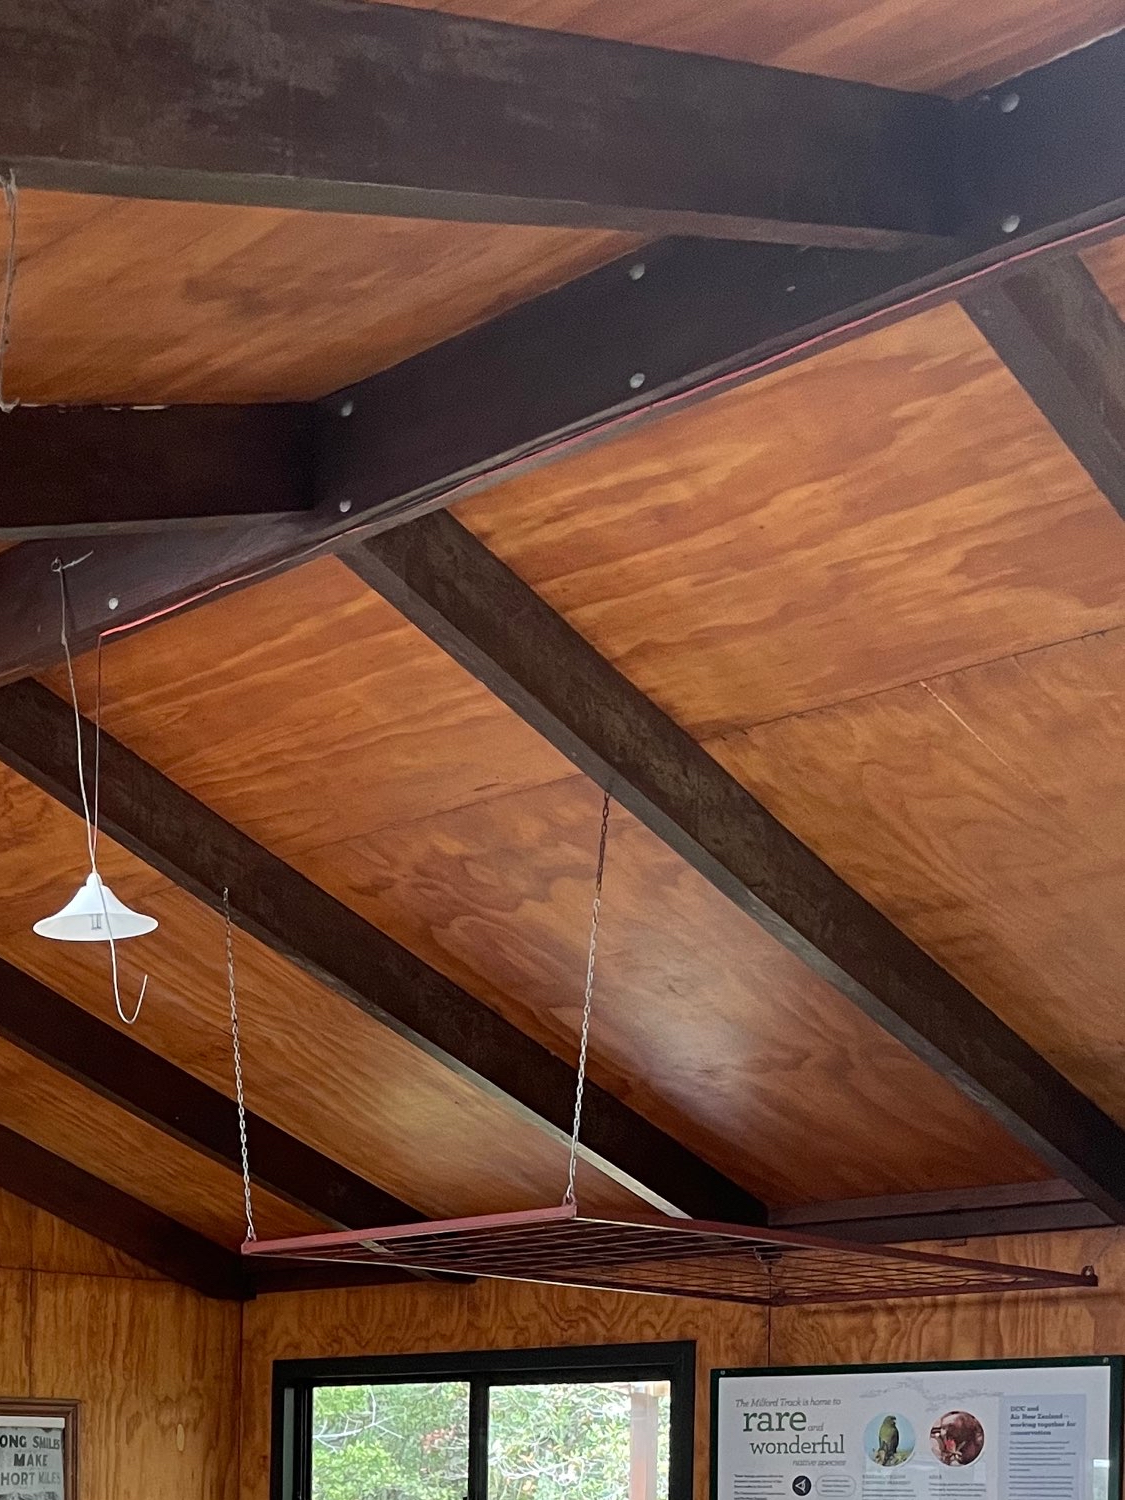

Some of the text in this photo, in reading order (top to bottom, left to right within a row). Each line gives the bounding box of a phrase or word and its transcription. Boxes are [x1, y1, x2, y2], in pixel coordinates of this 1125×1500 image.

[736, 1399, 749, 1407] The
[751, 1398, 778, 1407] Milford
[780, 1398, 800, 1406] Track
[810, 1397, 831, 1406] home
[743, 1411, 824, 1432] rare and
[32, 1436, 60, 1450] SMILES
[749, 1434, 845, 1454] wonderful
[13, 1454, 48, 1466] MAKE
